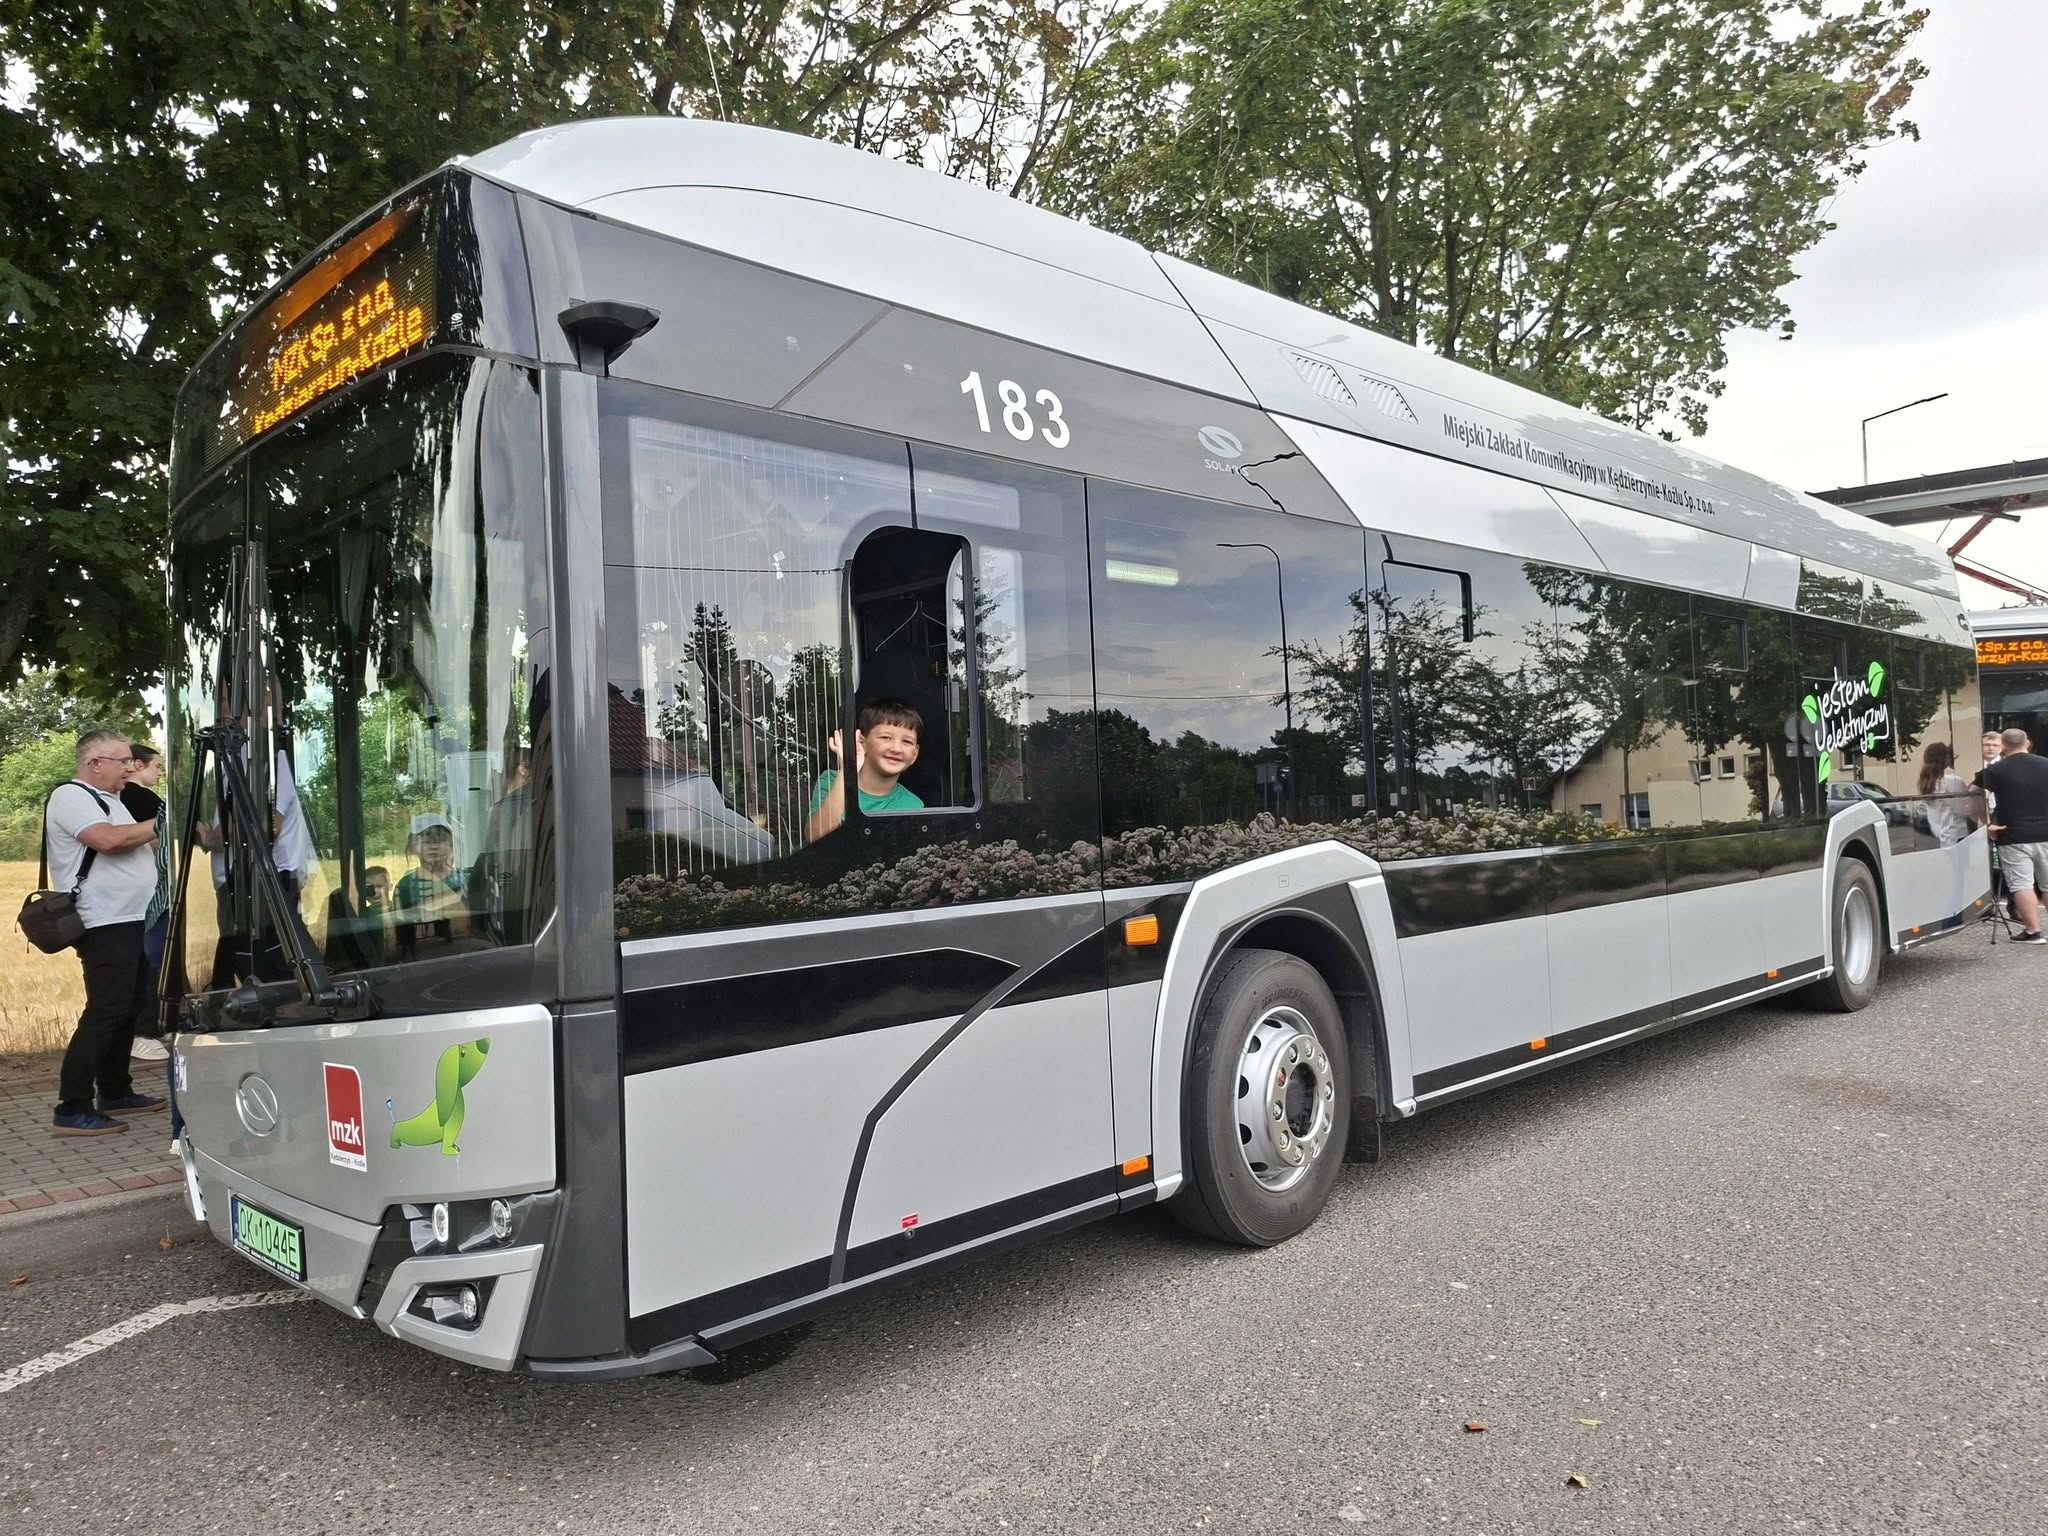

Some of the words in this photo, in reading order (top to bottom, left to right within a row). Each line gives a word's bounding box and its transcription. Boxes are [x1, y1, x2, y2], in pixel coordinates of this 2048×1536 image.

[960, 370, 1071, 449] 183
[1203, 458, 1249, 477] SOLARS
[1443, 413, 1485, 449] Miejski
[1486, 427, 1523, 460] Zakład
[1524, 440, 1597, 485] Komunikacyjny
[1598, 468, 1606, 484] w
[1607, 466, 1683, 508] Kędzierzynie-Koźlu
[1684, 490, 1697, 513] Sp.
[1697, 498, 1702, 511] z
[1702, 501, 1715, 515] o.o.
[1985, 641, 2006, 653] Sp.
[2008, 642, 2018, 651] z
[2020, 640, 2046, 650] o.o.
[1814, 665, 1870, 752] jestem
[1826, 703, 1889, 754] elektryczny
[331, 1116, 361, 1146] mzk
